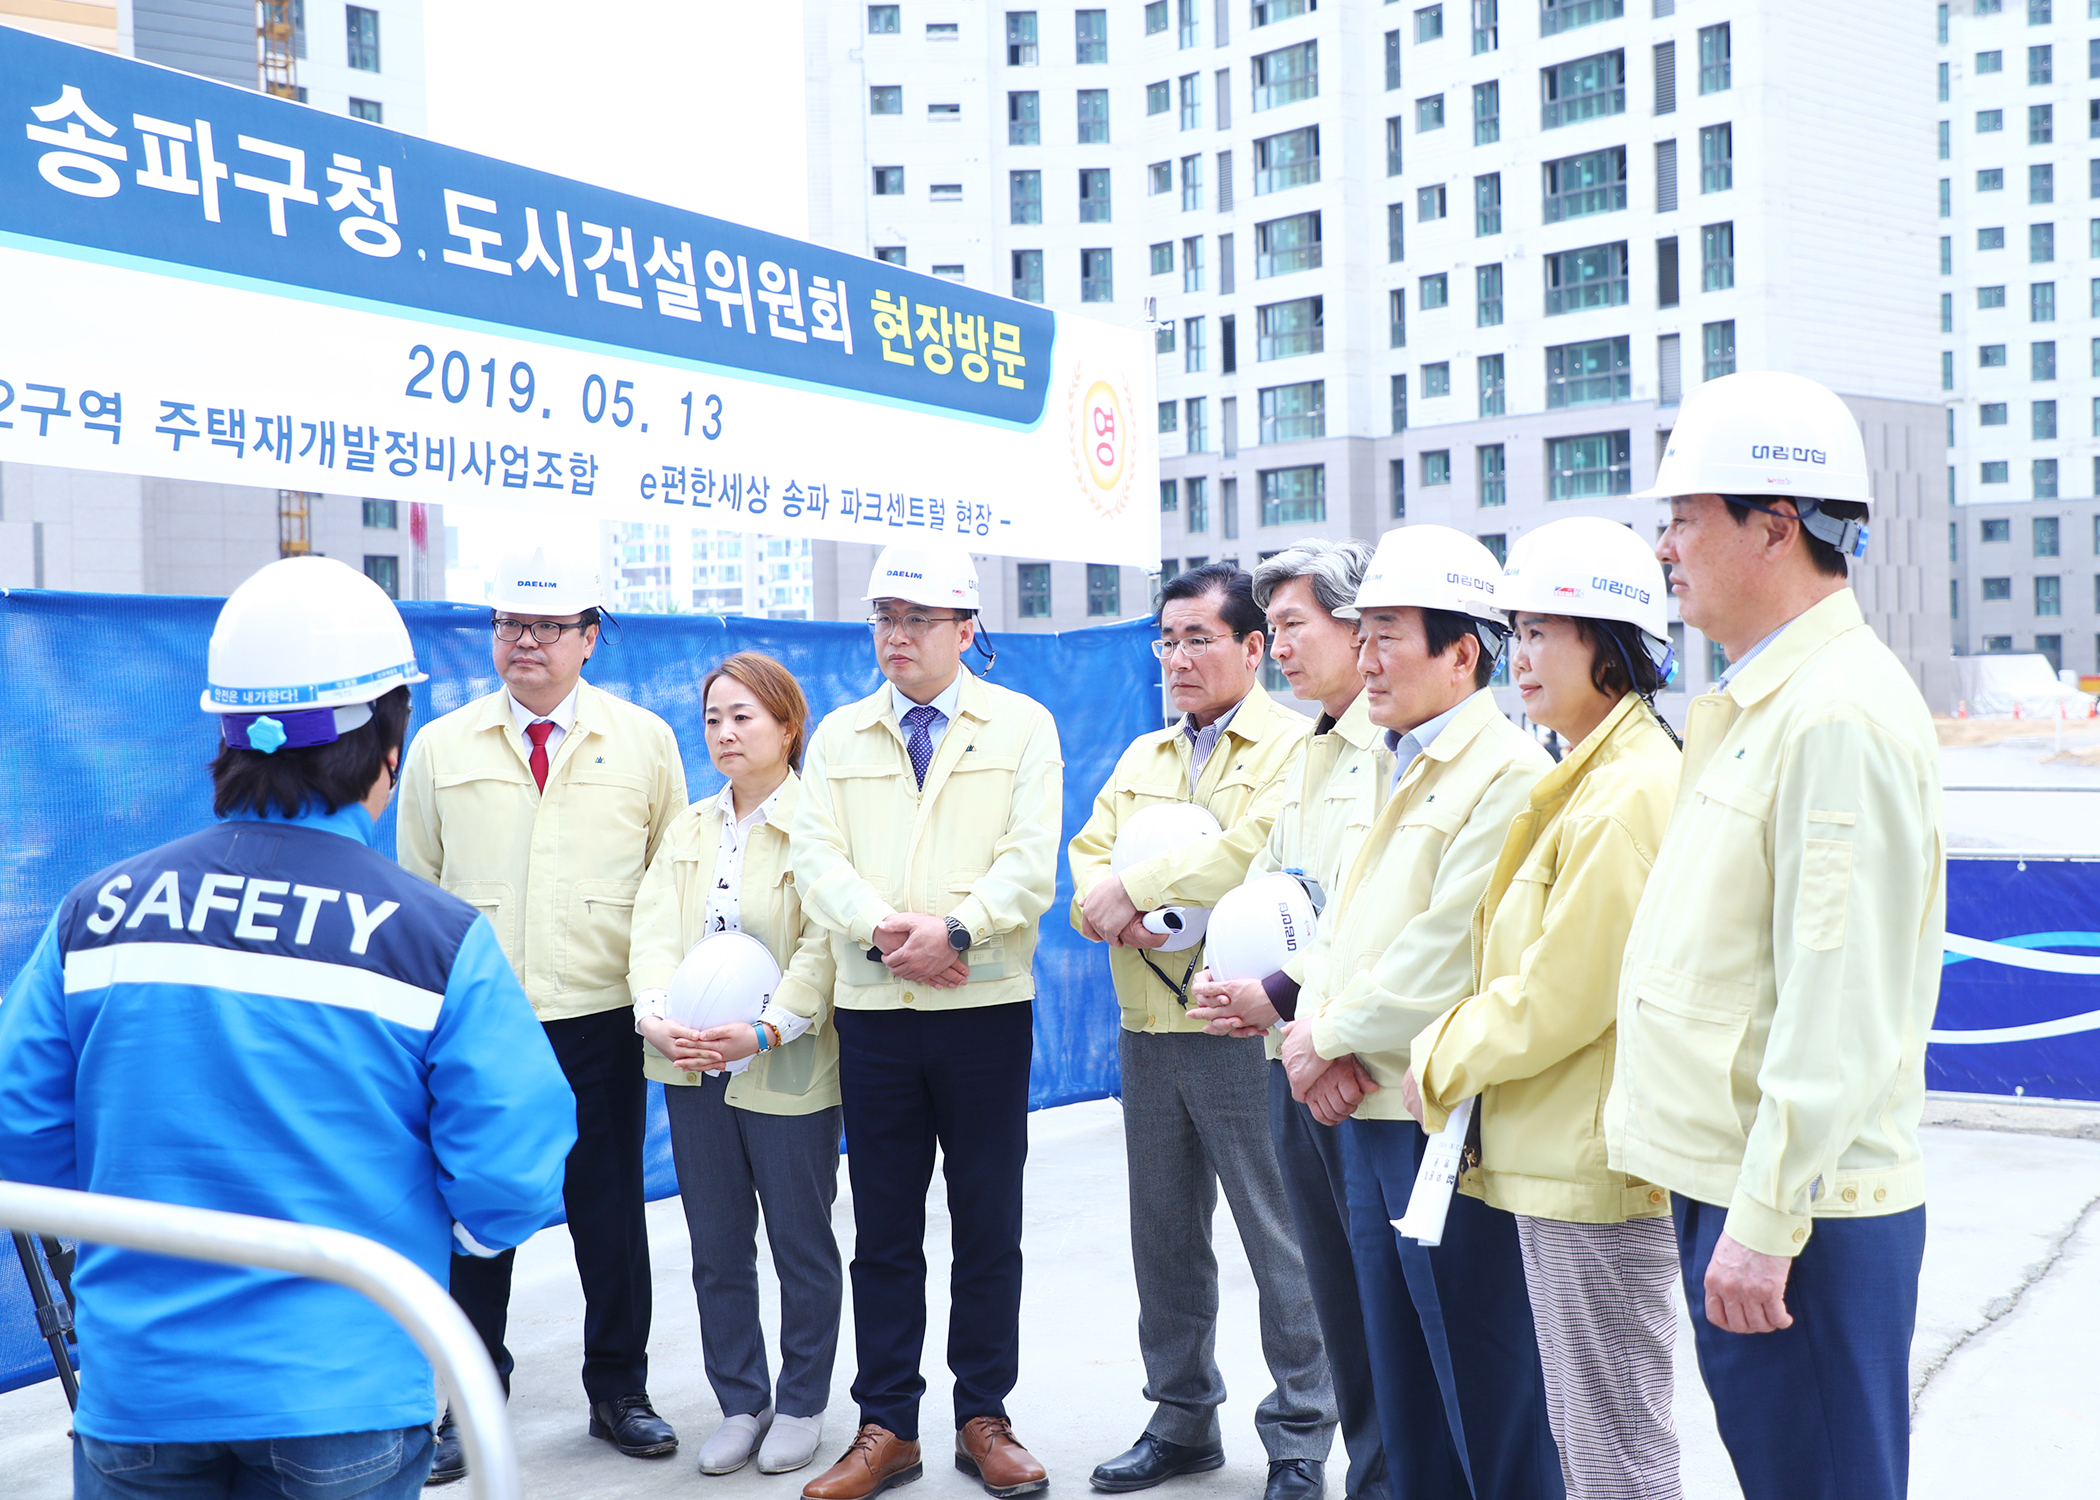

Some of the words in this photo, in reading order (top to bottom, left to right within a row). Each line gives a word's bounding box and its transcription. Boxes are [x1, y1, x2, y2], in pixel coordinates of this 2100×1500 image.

[442, 188, 854, 355] 도시건설위원회
[870, 289, 1026, 390] 현장방문
[404, 344, 550, 419] 2019.
[582, 373, 649, 433] 05.
[680, 391, 723, 440] 13
[154, 399, 599, 496] 주택재개발정비사업조합
[640, 465, 771, 514] e편한세상
[782, 479, 830, 520] 송파
[840, 487, 945, 531] 파크센트럴
[955, 499, 993, 537] 현장
[1093, 406, 1115, 467] 영
[517, 580, 557, 589] DAELIM
[887, 570, 923, 580] DAELIM
[214, 688, 239, 703] 안전은
[243, 688, 299, 704] 내가한다!
[86, 870, 401, 955] SAFETY
